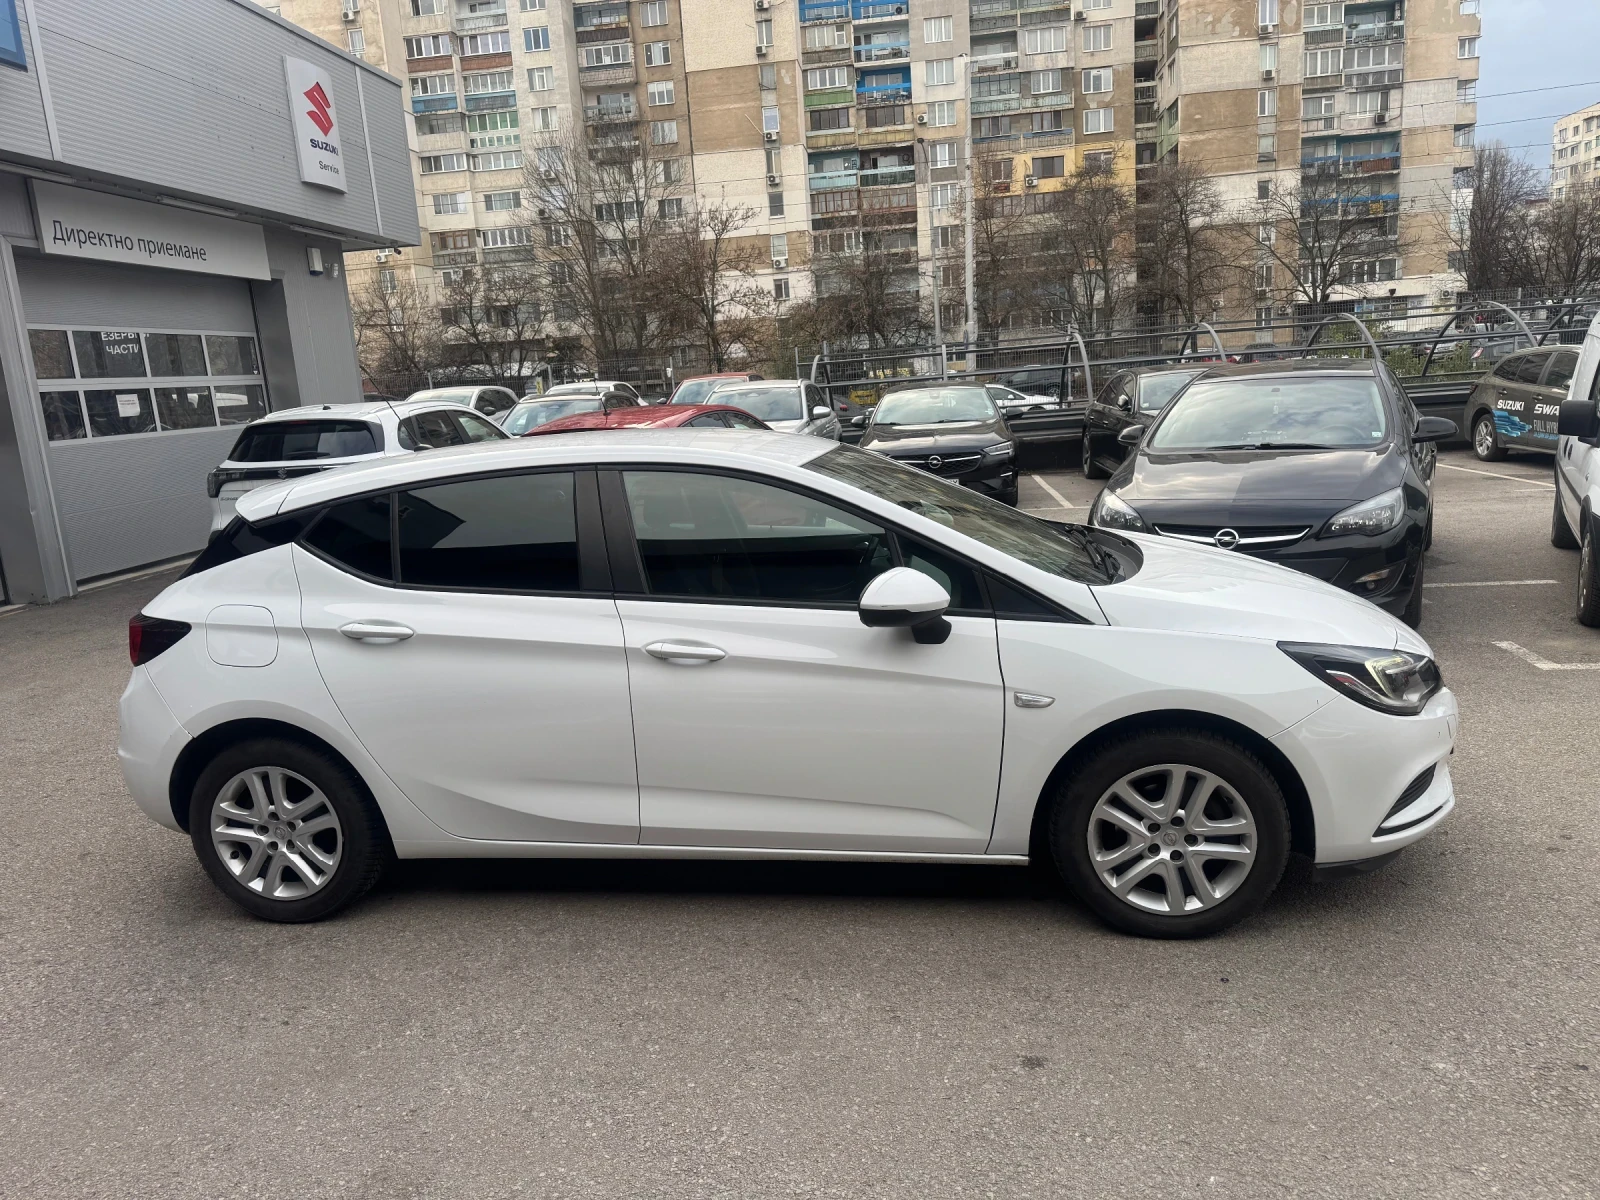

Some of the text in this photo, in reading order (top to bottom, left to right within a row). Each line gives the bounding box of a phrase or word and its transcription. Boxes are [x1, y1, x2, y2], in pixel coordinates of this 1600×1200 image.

[310, 138, 339, 156] SUZUKI
[319, 160, 340, 175] Service
[52, 220, 207, 261] Директно приемане
[1497, 400, 1560, 415] SUZUKI SWA
